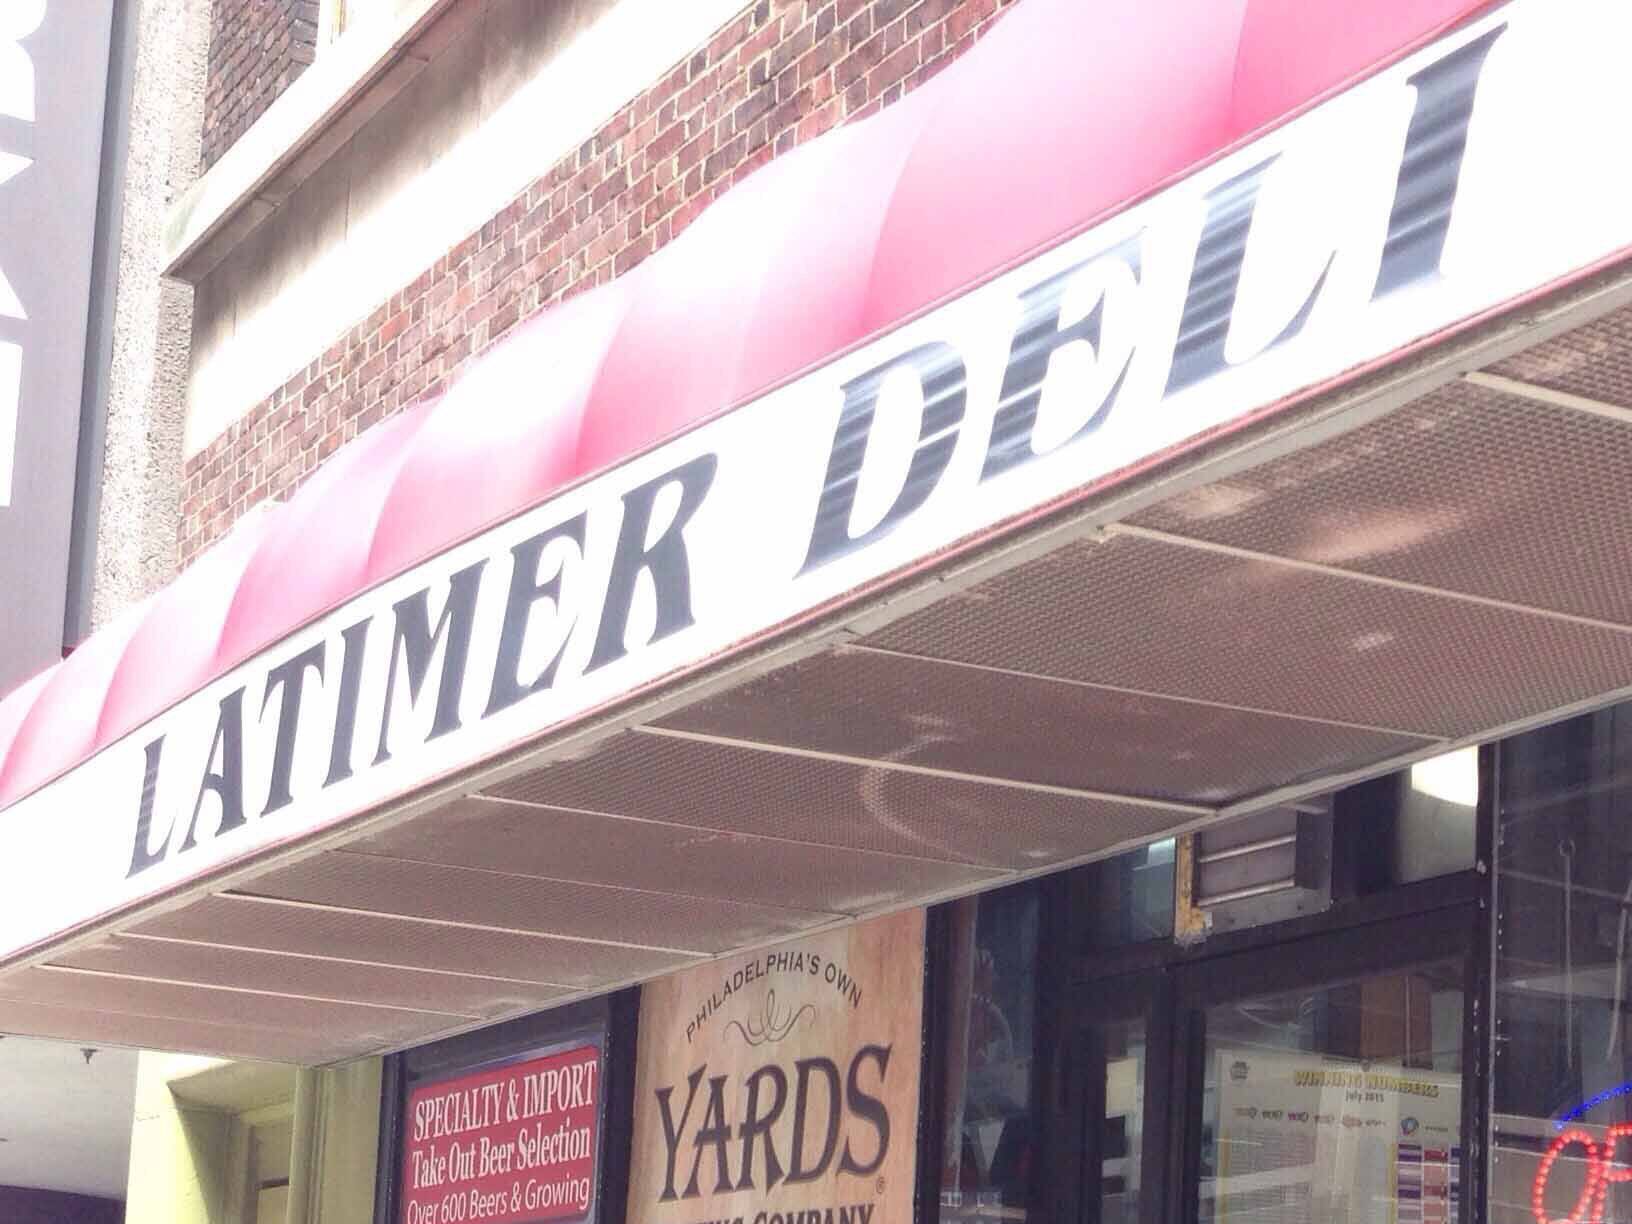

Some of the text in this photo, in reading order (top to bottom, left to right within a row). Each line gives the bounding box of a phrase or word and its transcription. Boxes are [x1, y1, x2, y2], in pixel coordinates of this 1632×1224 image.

[125, 22, 1508, 878] LATIMER DELI
[686, 951, 862, 1044] PHILADELPHIA'S OWN
[414, 1060, 597, 1142] SPECIALTY & IMPORT
[655, 1044, 892, 1202] YARDS
[413, 1117, 590, 1189] Take Out Beer Selection
[440, 1192, 467, 1222] 600
[470, 1189, 508, 1220] Beers
[511, 1181, 521, 1213] &
[525, 1172, 590, 1211] Growing
